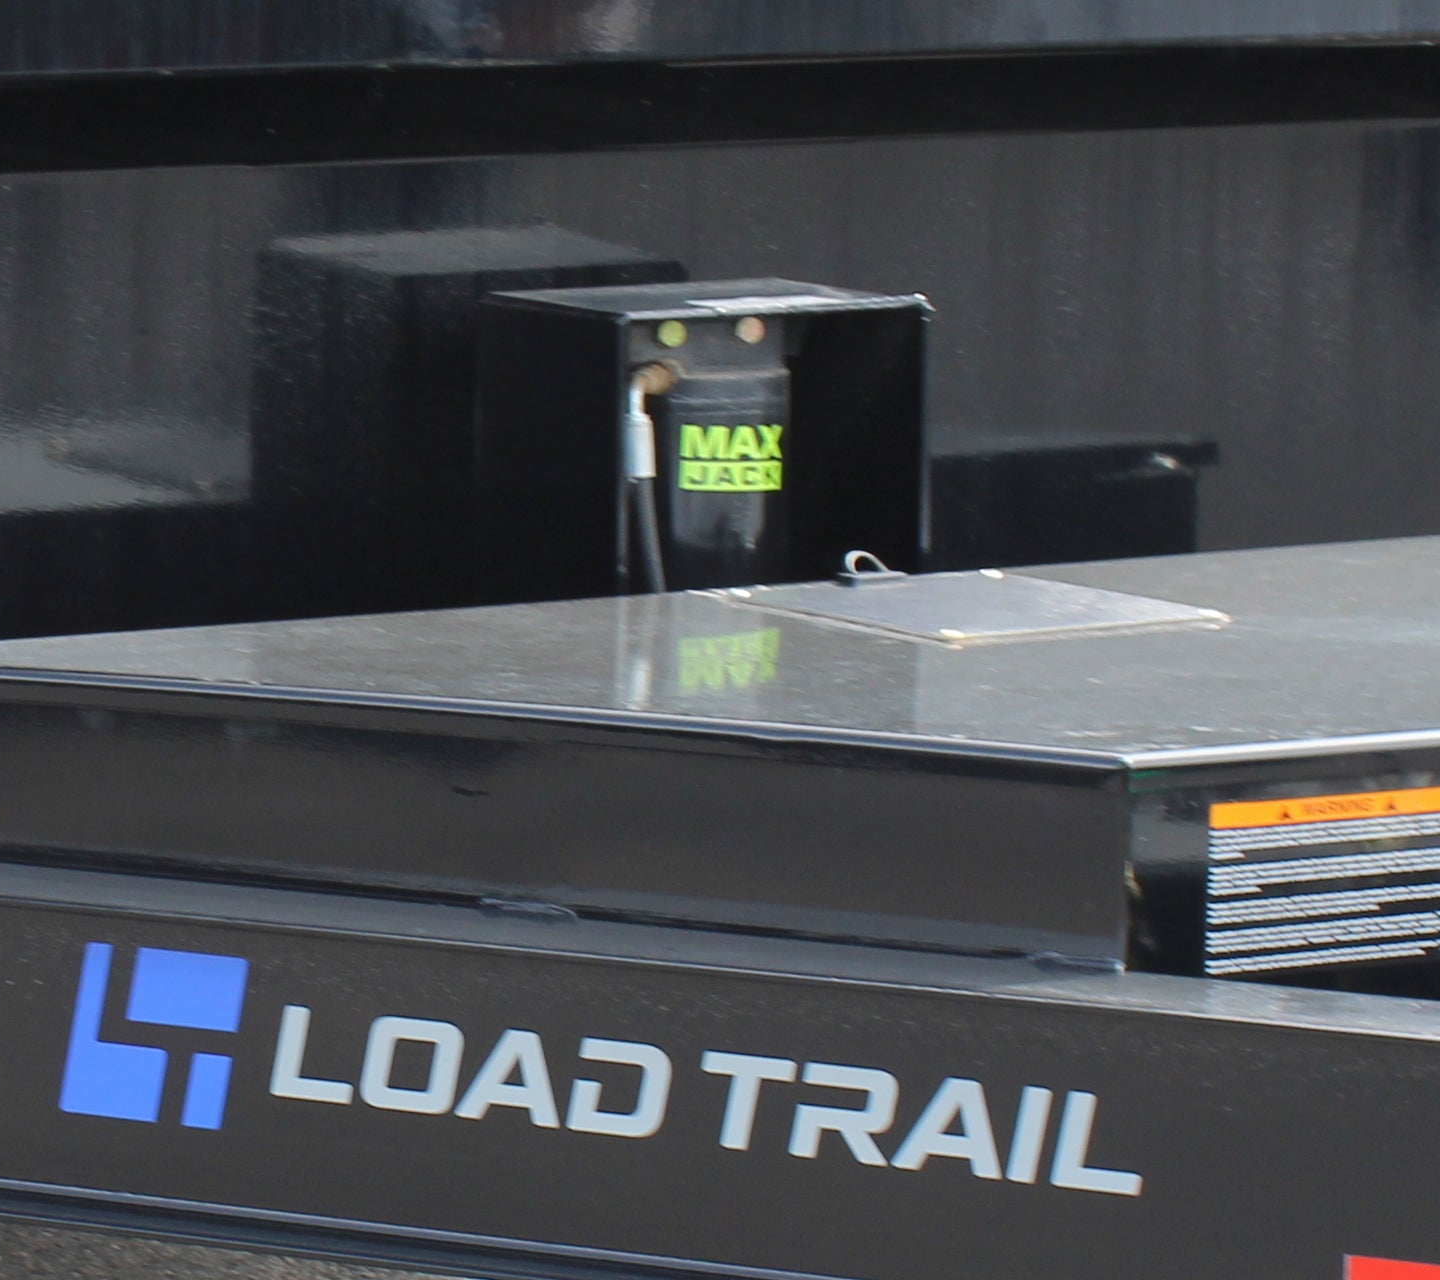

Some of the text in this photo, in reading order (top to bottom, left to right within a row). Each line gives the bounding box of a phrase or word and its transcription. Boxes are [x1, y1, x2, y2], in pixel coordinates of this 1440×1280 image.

[680, 424, 783, 459] MAX
[684, 464, 782, 487] JACK
[269, 1005, 1143, 1196] LOAD TRAIL
